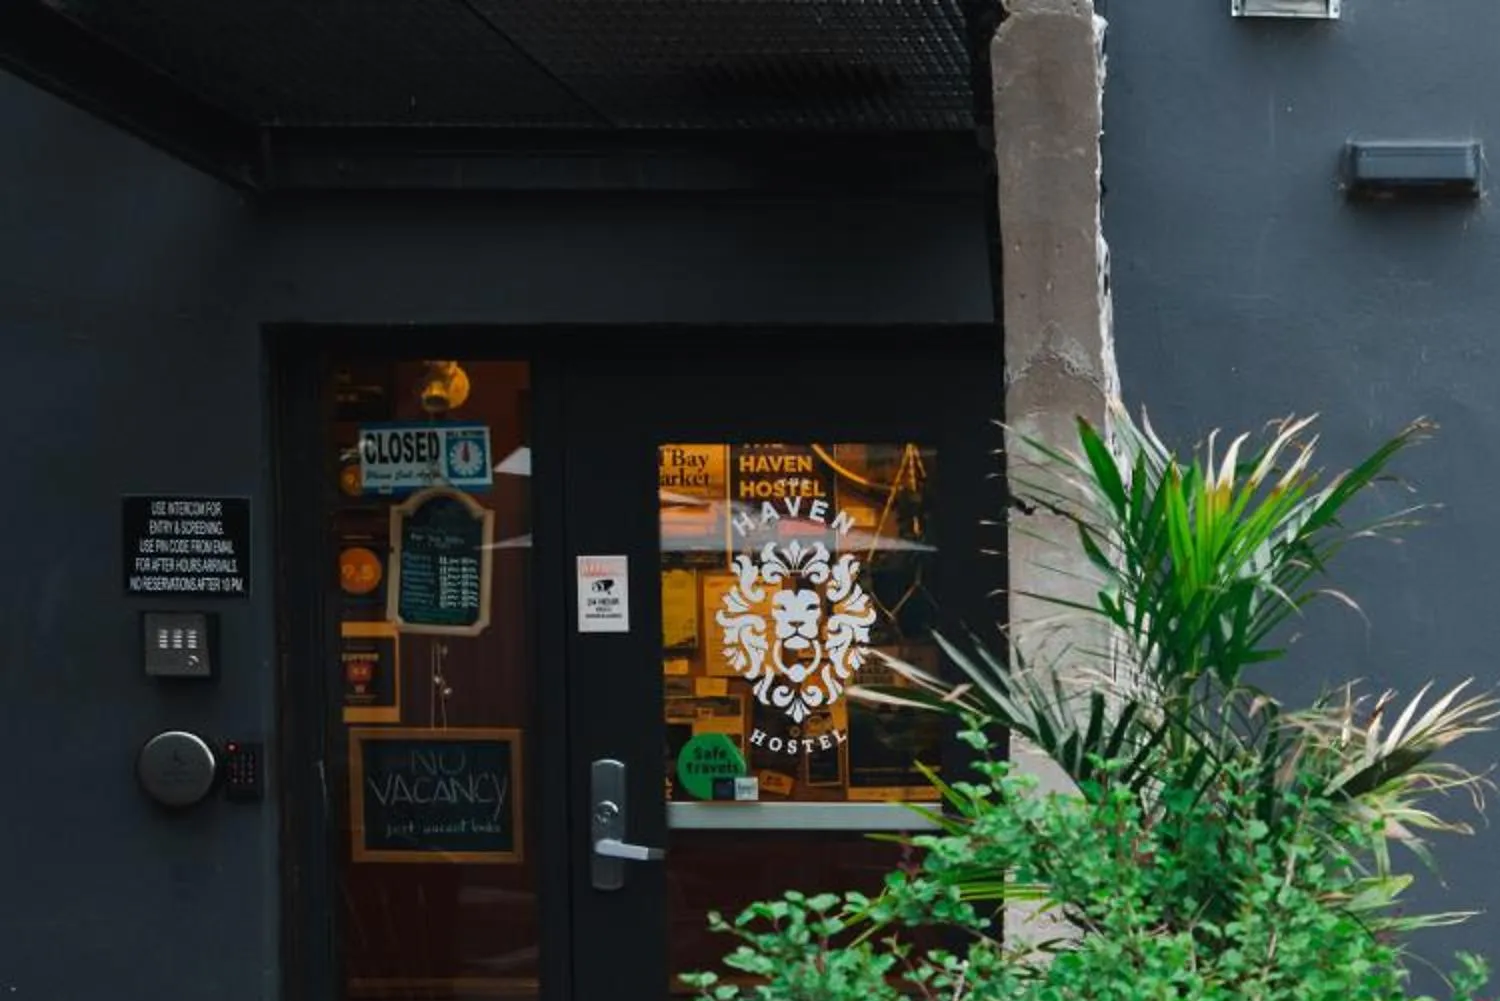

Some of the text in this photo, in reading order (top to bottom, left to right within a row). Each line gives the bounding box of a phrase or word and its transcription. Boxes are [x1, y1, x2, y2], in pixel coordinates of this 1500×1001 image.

[364, 430, 440, 465] CLOSED
[672, 447, 710, 470] Bay
[739, 455, 813, 473] HAVEN
[739, 479, 826, 498] HOSTEL
[151, 500, 223, 516] USE INTERCOM FOR
[732, 495, 856, 537] HAVEN
[149, 519, 172, 536] ENTRY
[139, 538, 155, 554] USE
[156, 538, 169, 554] PIN
[170, 538, 190, 554] CODE
[191, 538, 212, 554] FROM
[135, 556, 151, 573] FOR
[152, 556, 175, 573] AFTER
[175, 556, 203, 574] HOURS
[130, 576, 142, 592] NO
[142, 576, 197, 592] RESERVATIONS
[197, 576, 221, 592] AFTER
[221, 576, 230, 592] 10
[749, 728, 847, 755] HOSTEL
[411, 748, 466, 775] NO
[693, 746, 728, 760] Safe
[686, 761, 739, 776] travels
[367, 768, 508, 822] VACANCY
